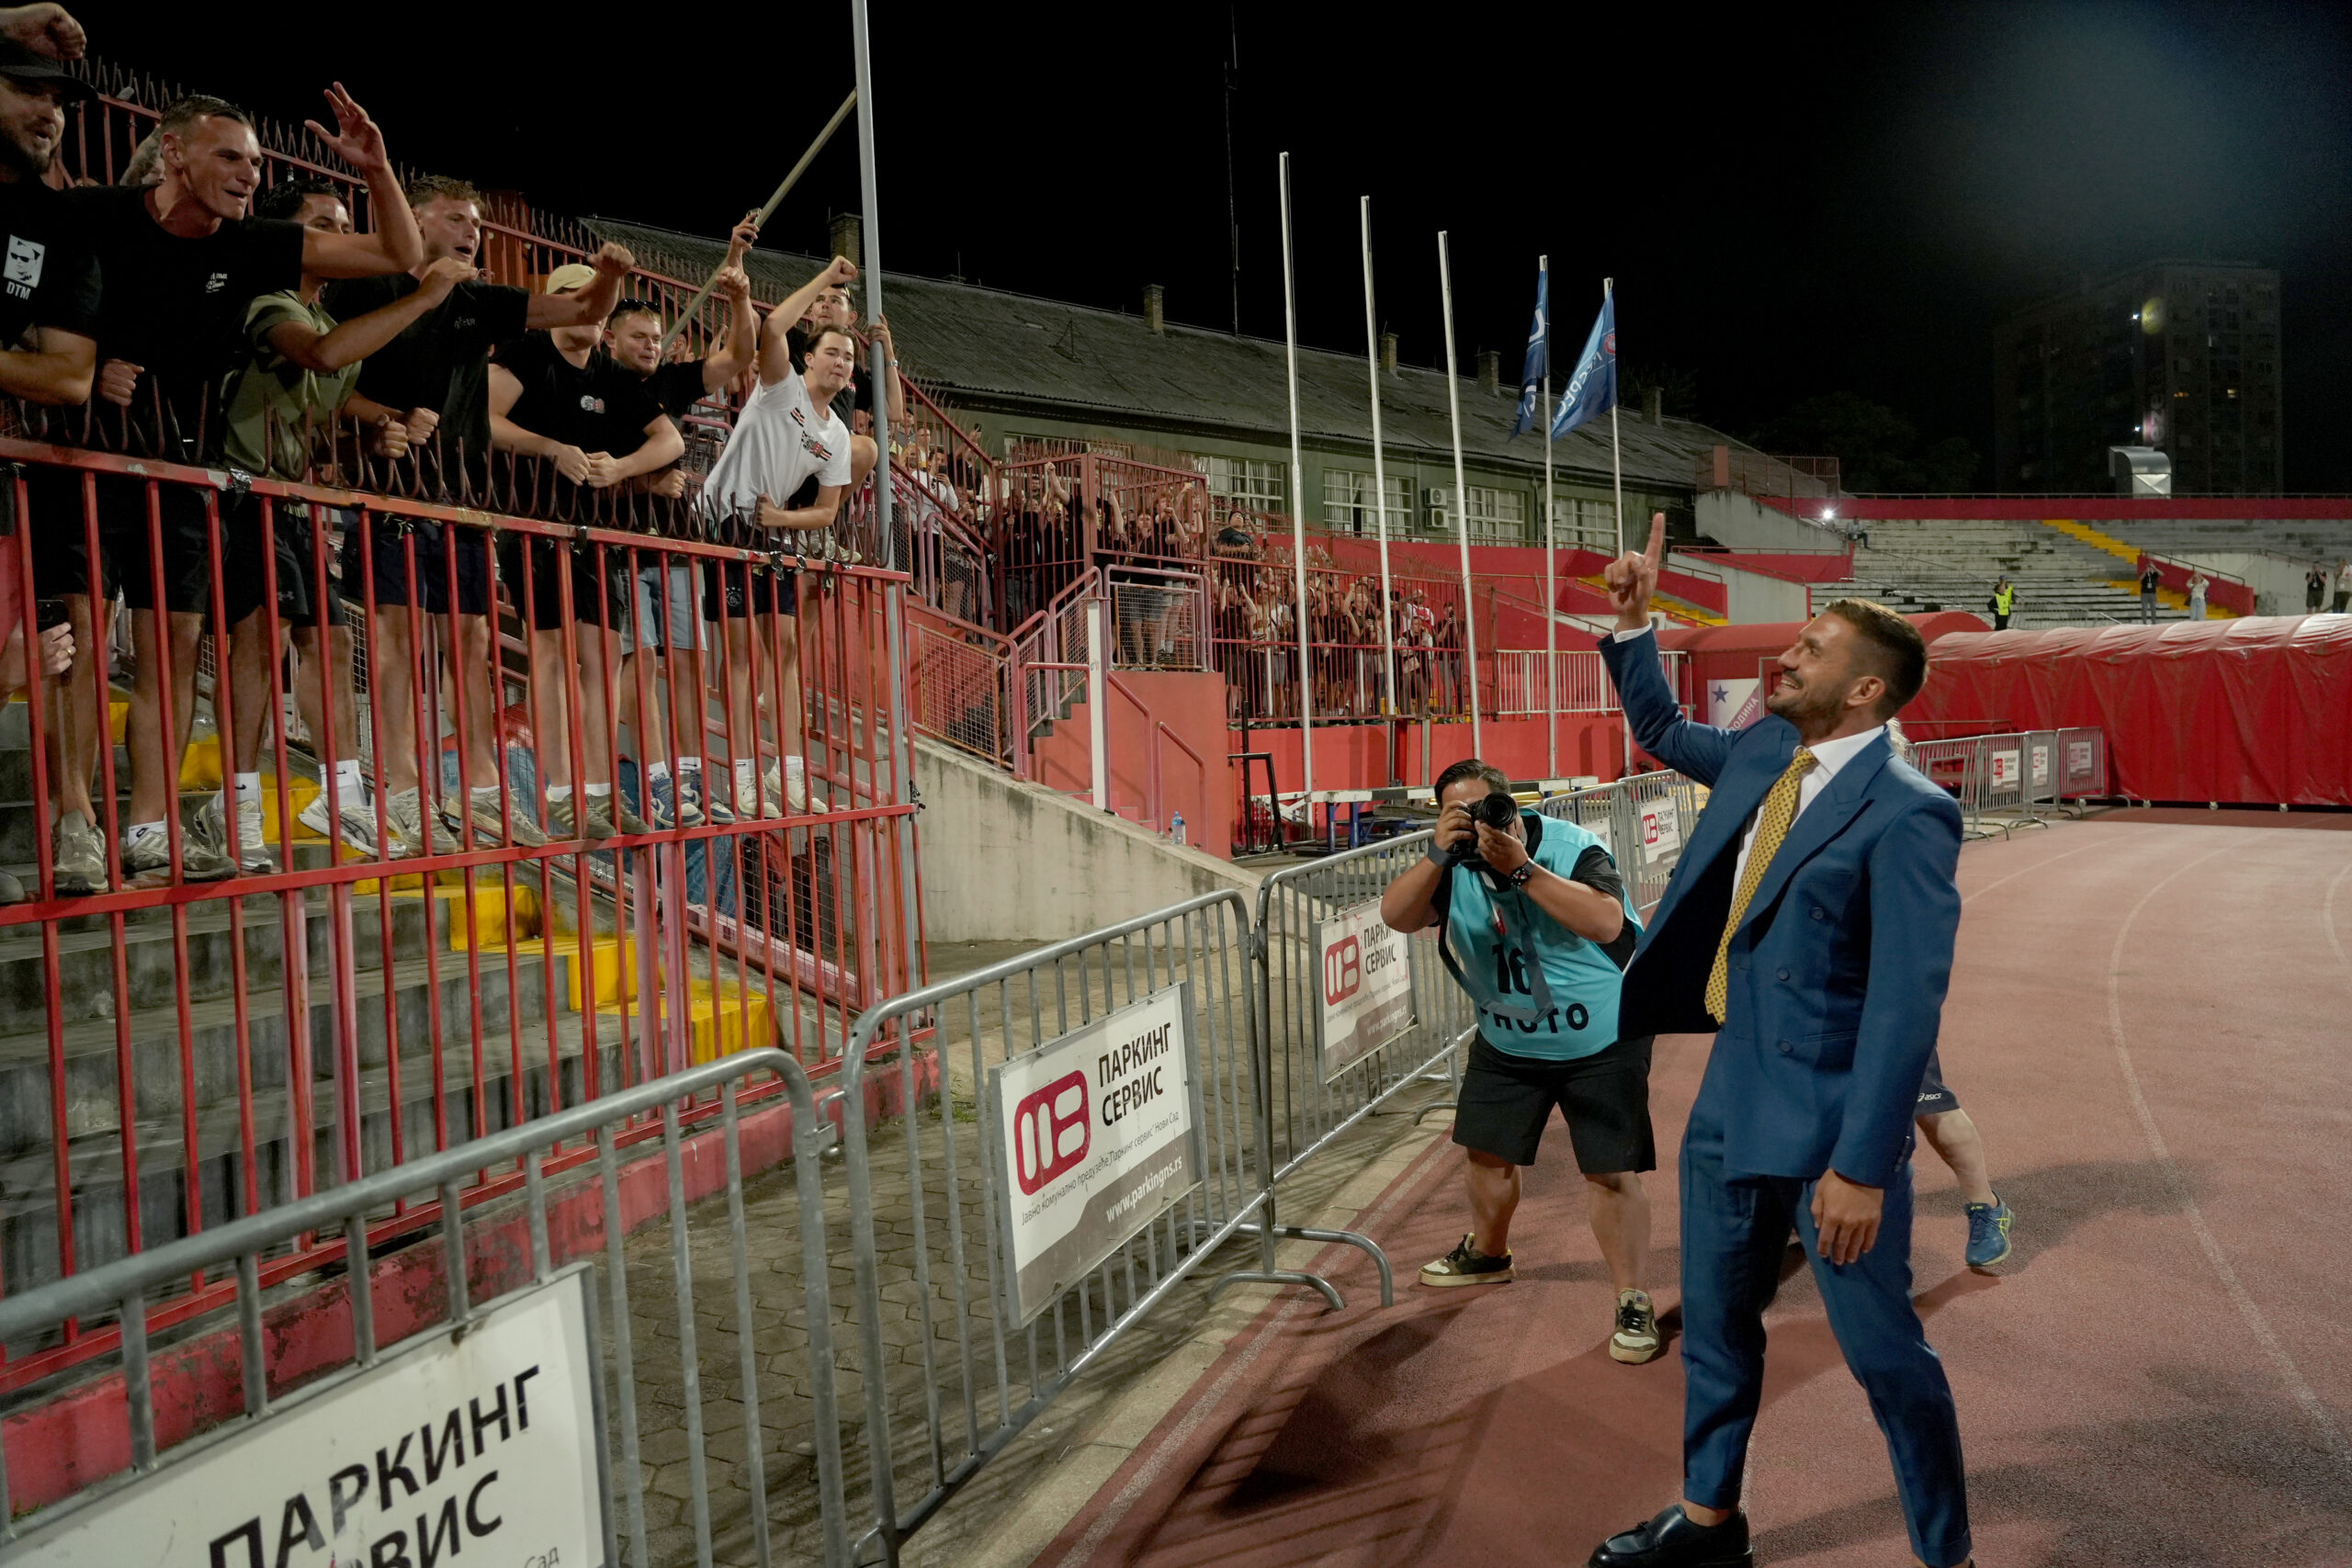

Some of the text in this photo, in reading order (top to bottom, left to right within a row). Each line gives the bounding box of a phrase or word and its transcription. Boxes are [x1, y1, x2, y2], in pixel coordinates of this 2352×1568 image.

[6, 280, 31, 300] DTM
[1729, 697, 1758, 732] ОДИНА
[1363, 922, 1396, 949] ПАРКИ
[1365, 943, 1396, 976] СЕРВИС
[1491, 943, 1532, 995] 16
[1479, 1003, 1589, 1033] HOTO
[1099, 1022, 1170, 1088] ПАРКИНГ
[1102, 1066, 1163, 1126] СЕРВИС
[1154, 1120, 1169, 1133] Нови
[1105, 1155, 1182, 1223] www.parkingns.rs
